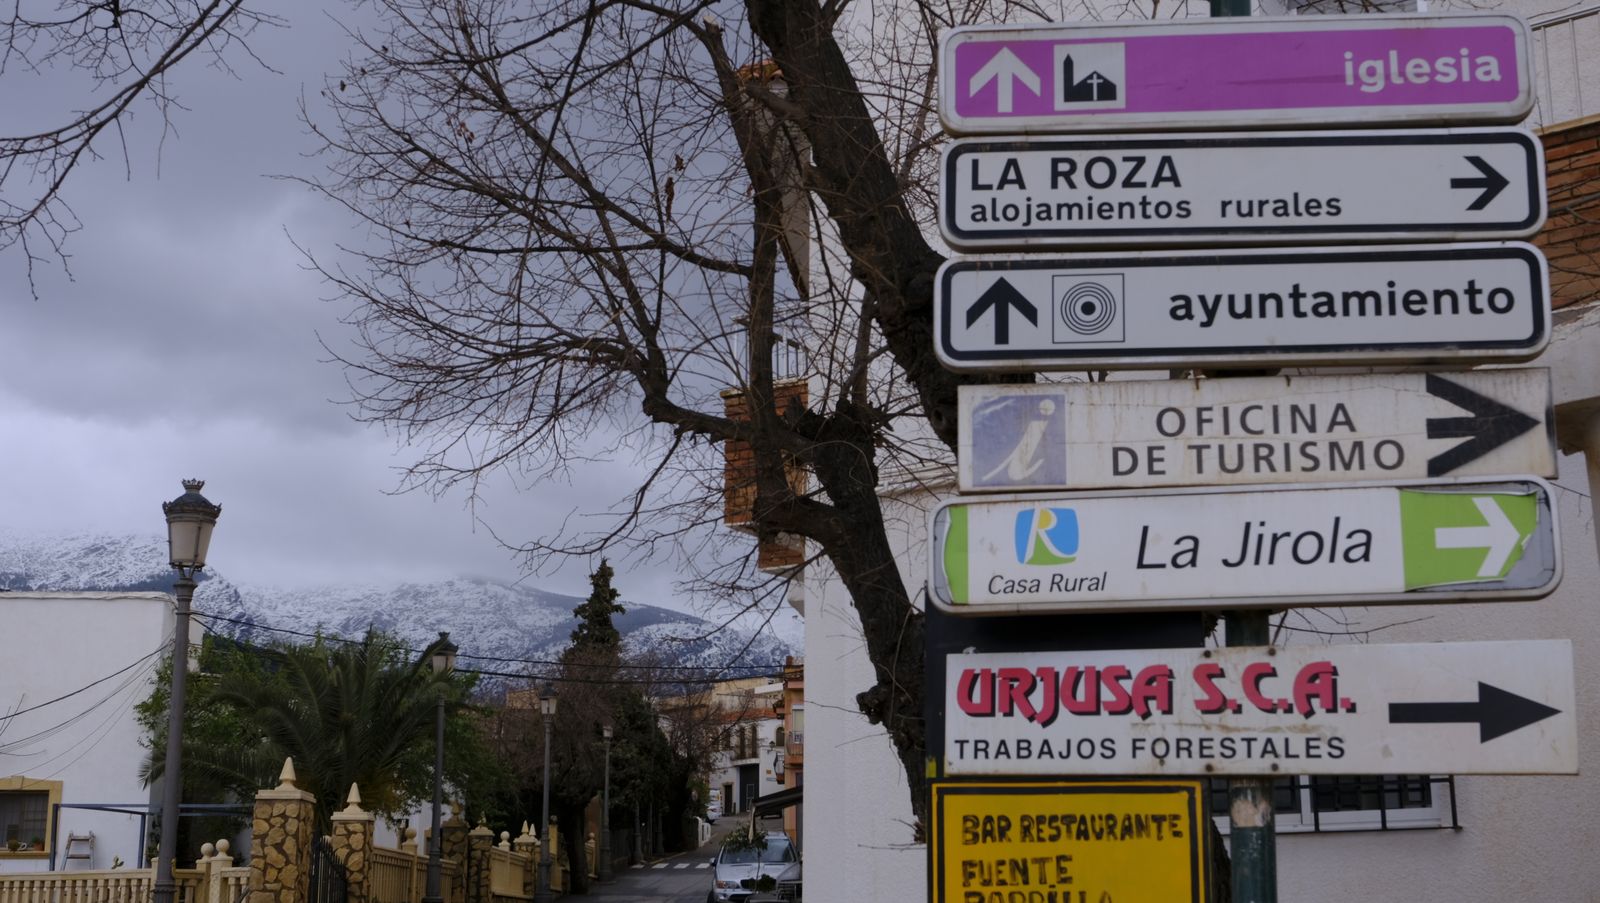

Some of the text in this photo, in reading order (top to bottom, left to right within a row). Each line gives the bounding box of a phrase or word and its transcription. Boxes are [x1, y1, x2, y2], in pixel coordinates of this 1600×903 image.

[1344, 48, 1502, 93] iglesia
[970, 155, 1182, 191] LA ROZA
[970, 193, 1343, 226] alojamientos rurales
[1169, 280, 1516, 329] ayuntamiento
[1156, 403, 1357, 437] OFICINA
[1112, 440, 1405, 476] DE TURISMO
[1136, 516, 1374, 570] La Jirola
[987, 572, 1108, 595] Casa Rural
[956, 661, 1357, 728] URJUSA S.C.A.
[954, 737, 1346, 760] TRABAJOS FORESTALES
[961, 814, 1184, 845] BAR RESTAURANTE
[961, 854, 1074, 887] FUENTE
